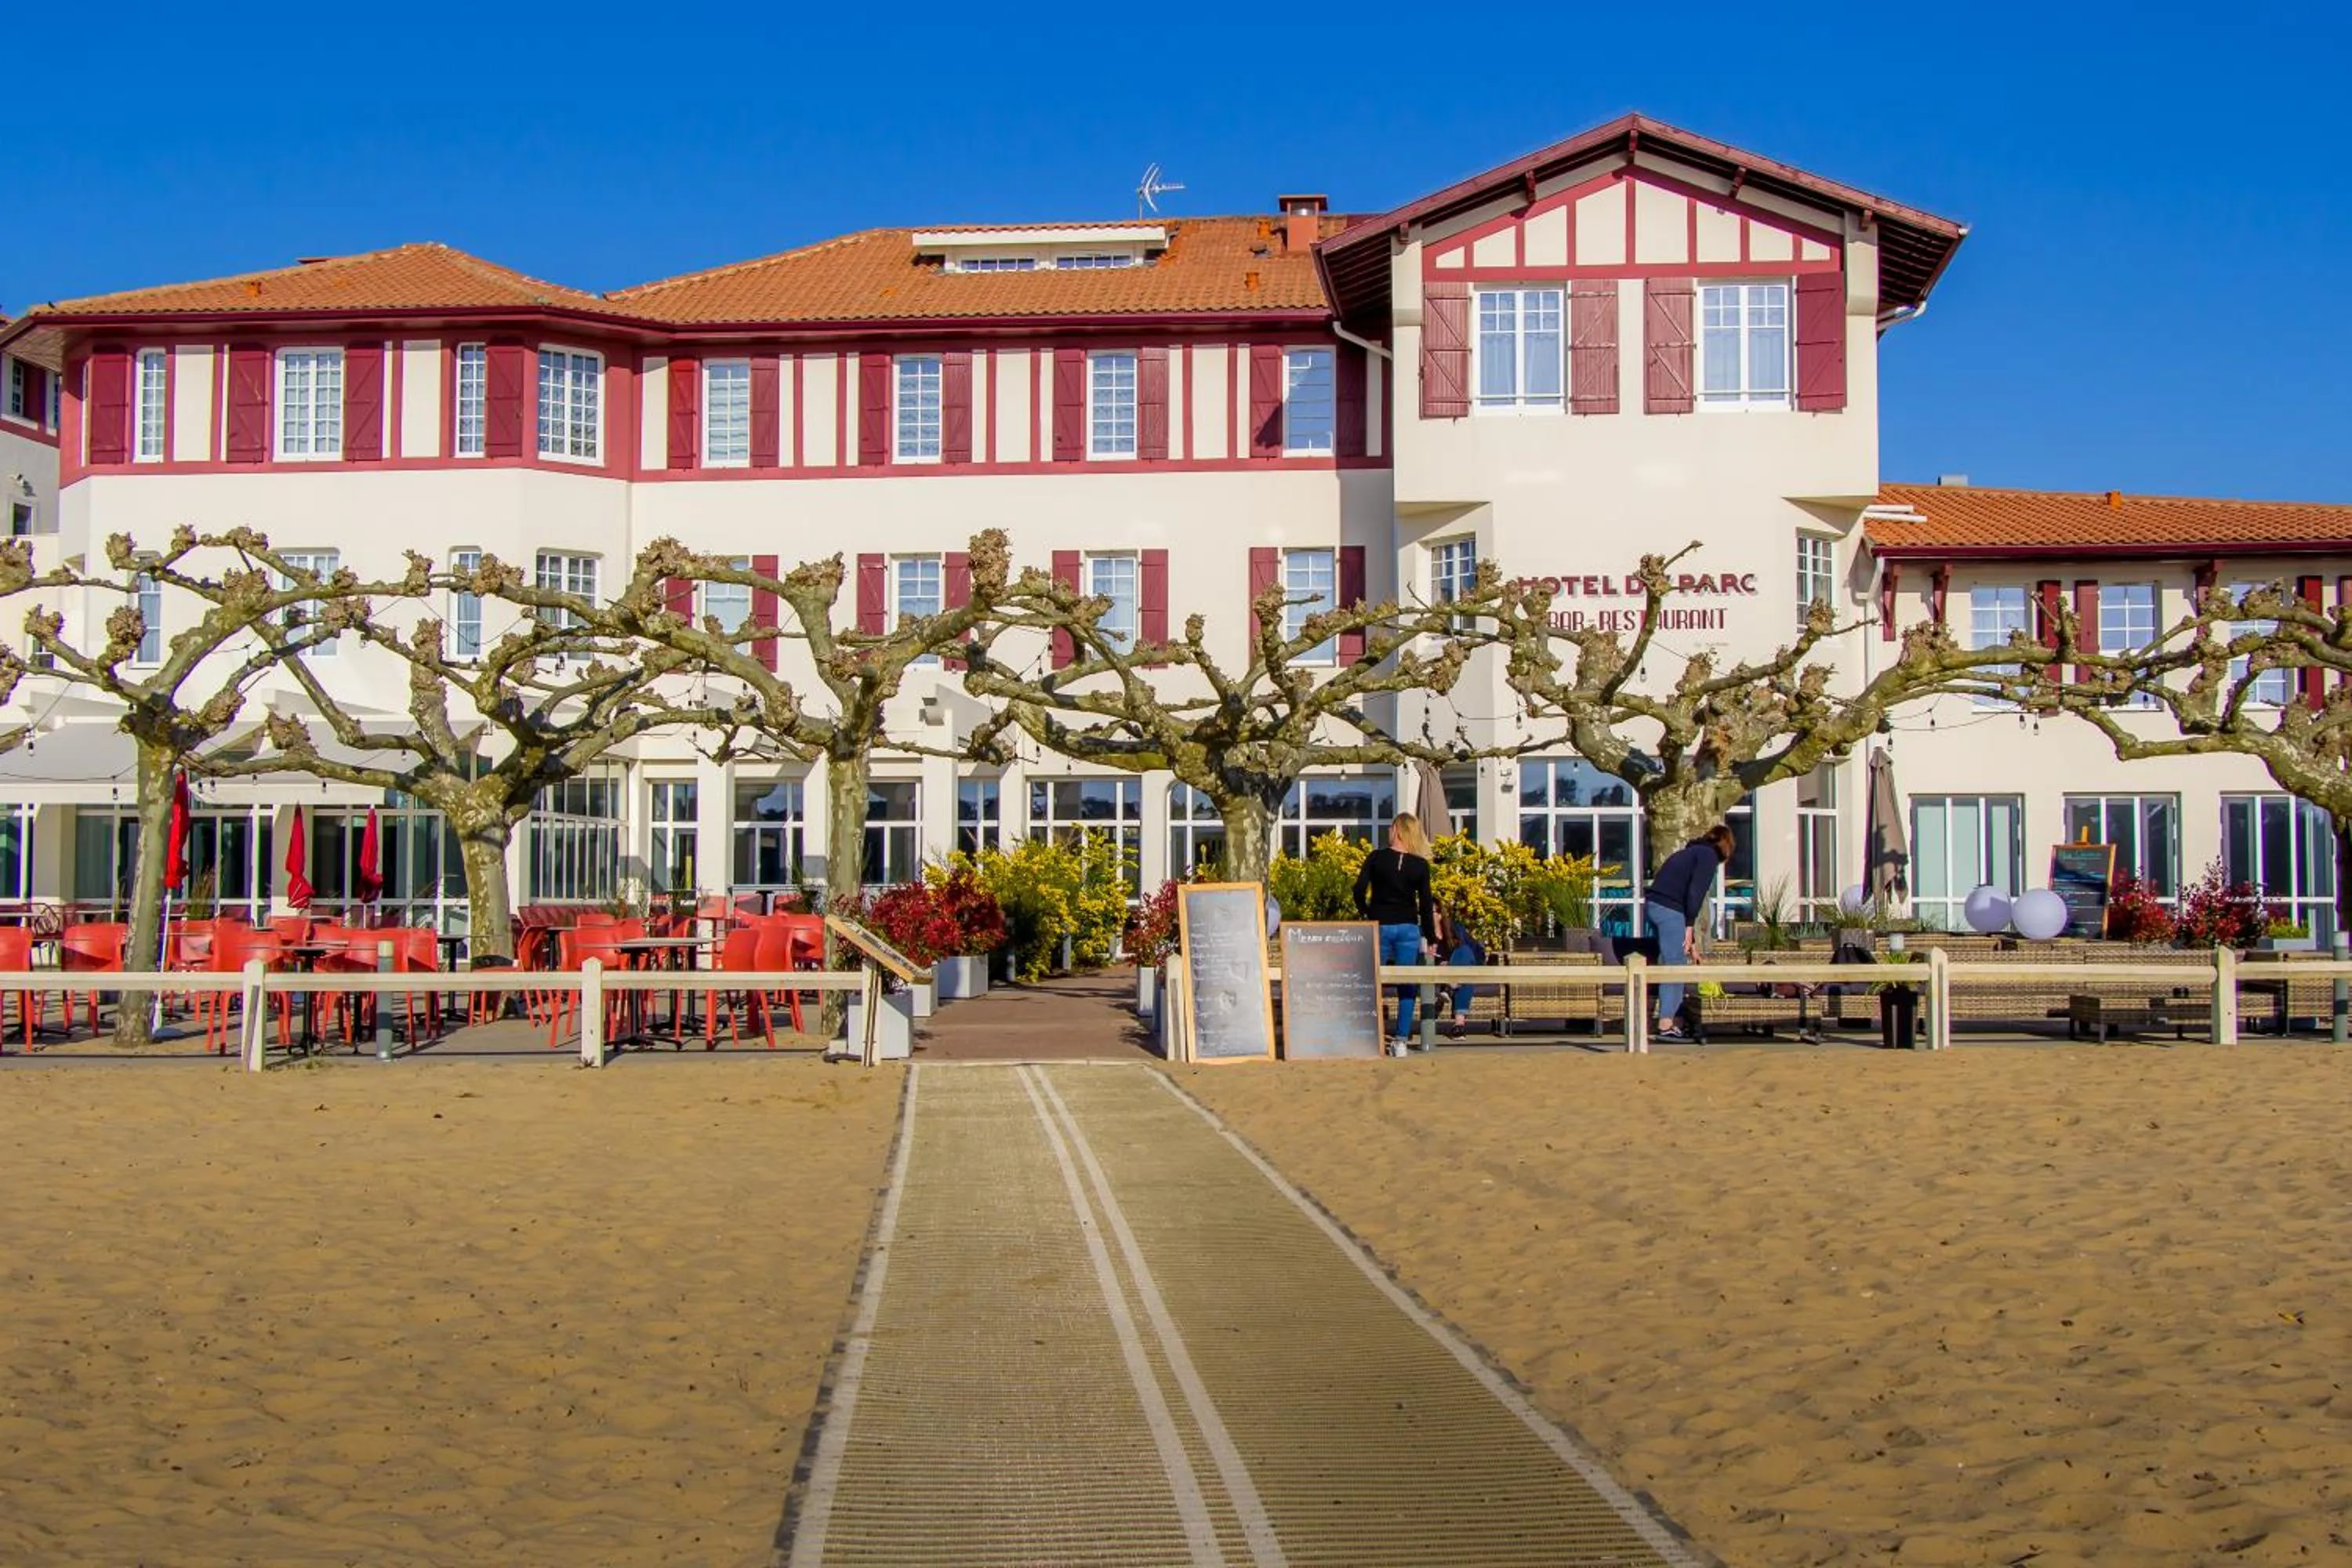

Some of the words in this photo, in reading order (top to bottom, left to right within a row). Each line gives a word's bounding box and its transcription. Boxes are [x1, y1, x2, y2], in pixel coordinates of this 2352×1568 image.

[1624, 575, 1671, 596] D
[1679, 572, 1758, 596] PARC
[1548, 610, 1584, 631] BAR
